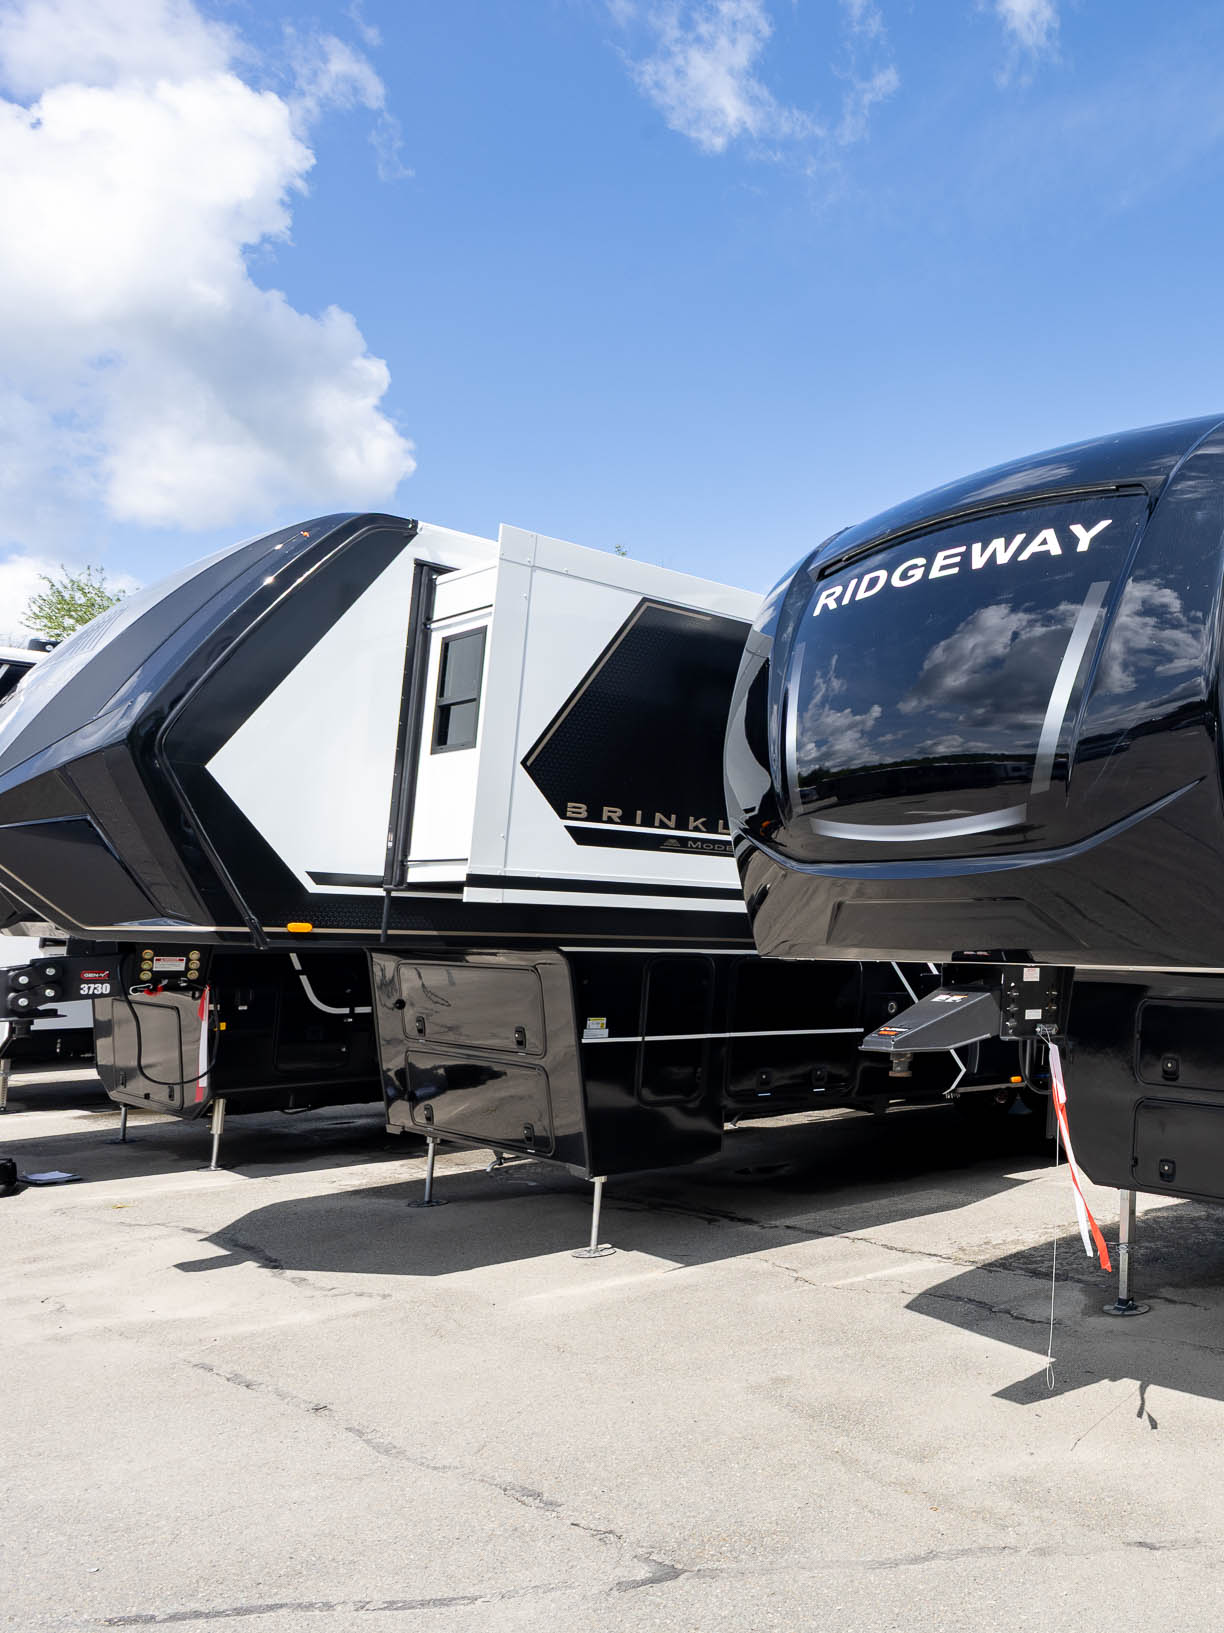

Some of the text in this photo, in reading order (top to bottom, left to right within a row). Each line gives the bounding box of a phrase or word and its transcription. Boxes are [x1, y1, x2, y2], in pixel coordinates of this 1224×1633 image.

[812, 519, 1113, 617] RIDGEWAY
[566, 802, 731, 834] BRINKL
[80, 983, 111, 995] 3730
